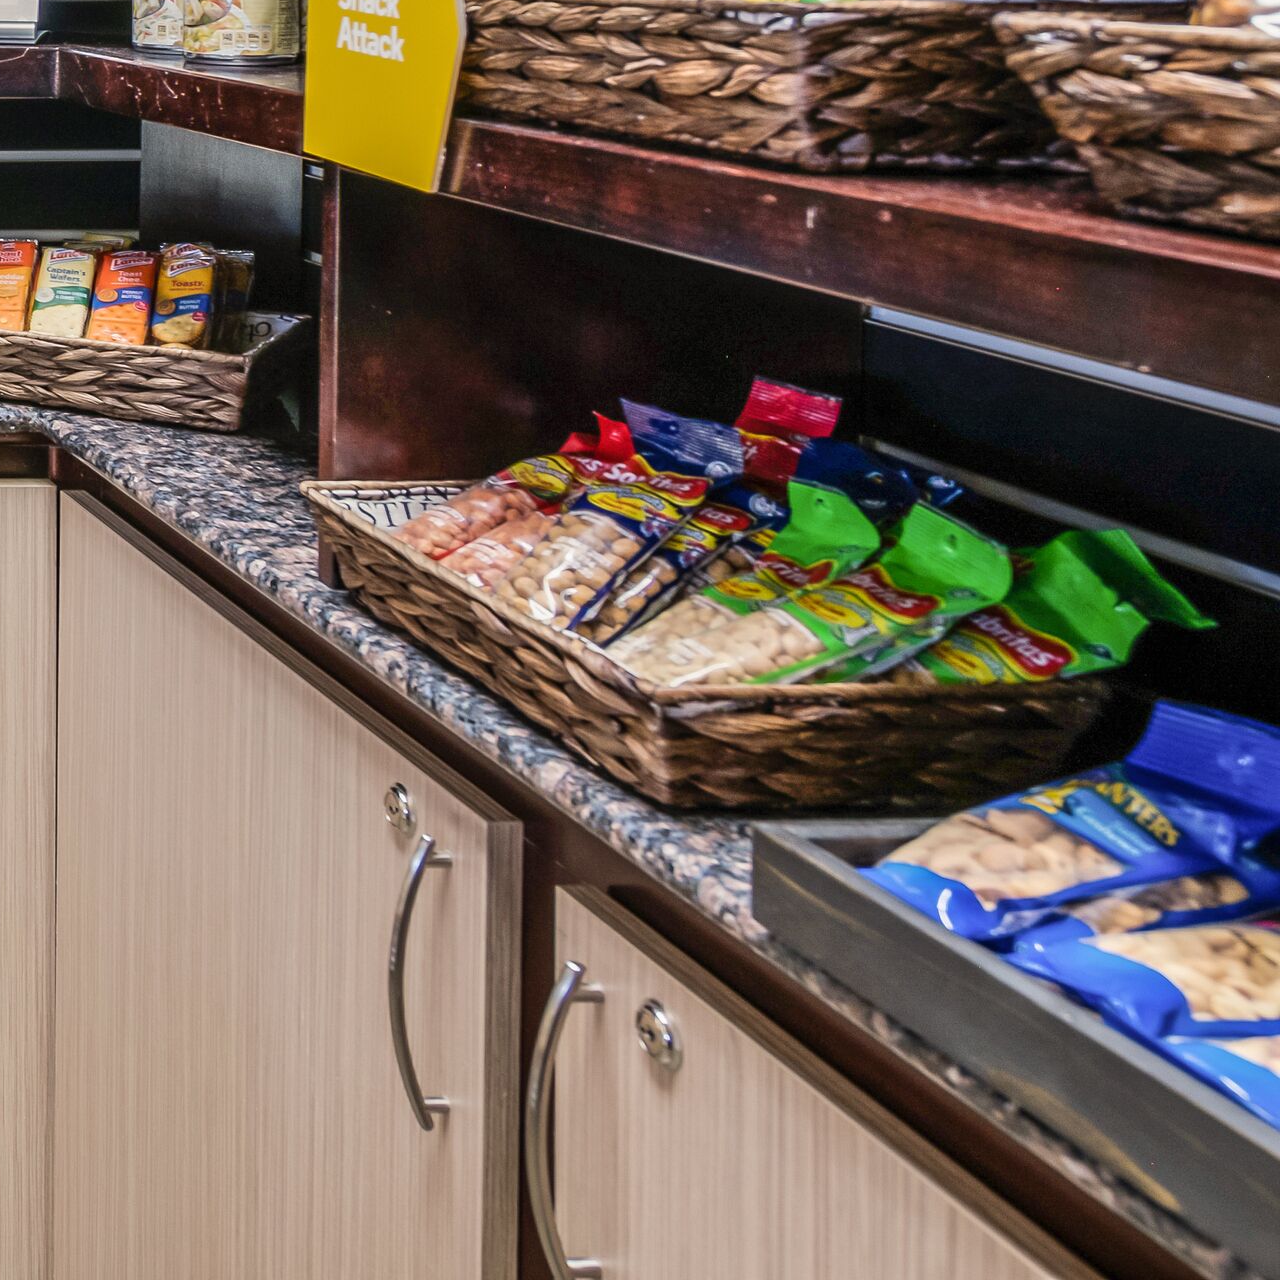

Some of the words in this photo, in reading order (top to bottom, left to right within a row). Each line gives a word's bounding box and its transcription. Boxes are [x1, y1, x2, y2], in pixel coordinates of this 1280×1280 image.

[336, 16, 405, 63] Attack
[112, 257, 153, 270] Lance
[46, 266, 86, 277] Captain's
[49, 273, 81, 283] Wafers
